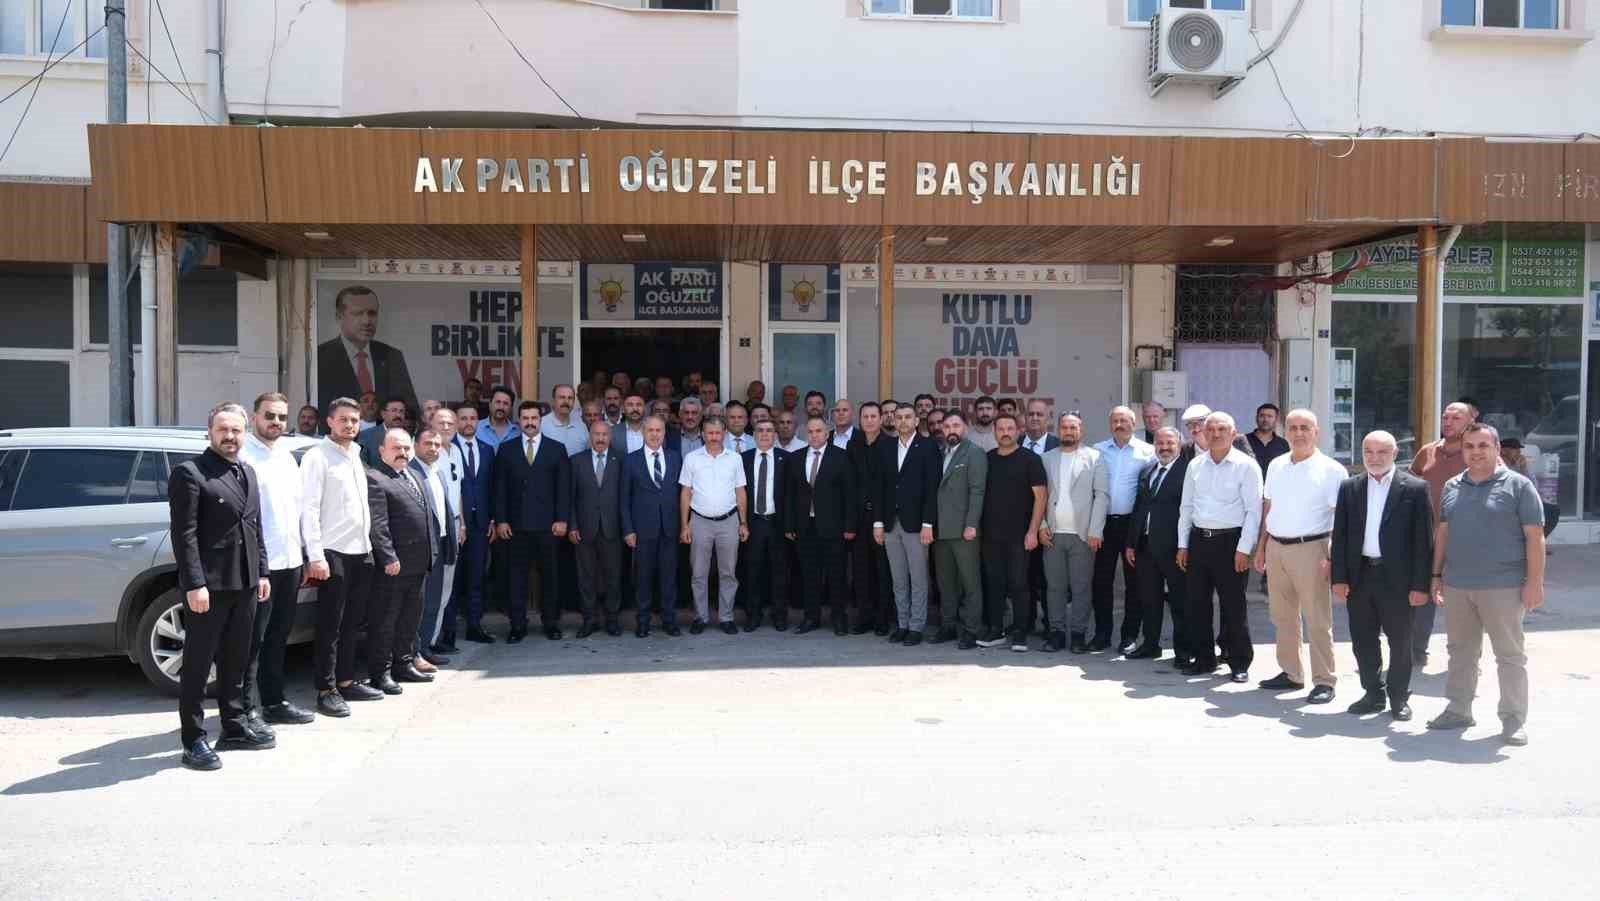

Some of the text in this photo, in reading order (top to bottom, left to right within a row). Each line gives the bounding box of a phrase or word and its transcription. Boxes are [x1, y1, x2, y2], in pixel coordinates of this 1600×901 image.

[414, 150, 1141, 205] AK PARTİ OĞUZELİ İLÇE BAŞKANLIĞI
[640, 271, 717, 286] AK PARTİ
[470, 291, 523, 322] HEP
[645, 288, 713, 303] OĞUZELİ
[942, 293, 1032, 325] KUTLU
[953, 326, 1019, 357] DAVA
[933, 359, 1040, 395] GÜÇLÜ
